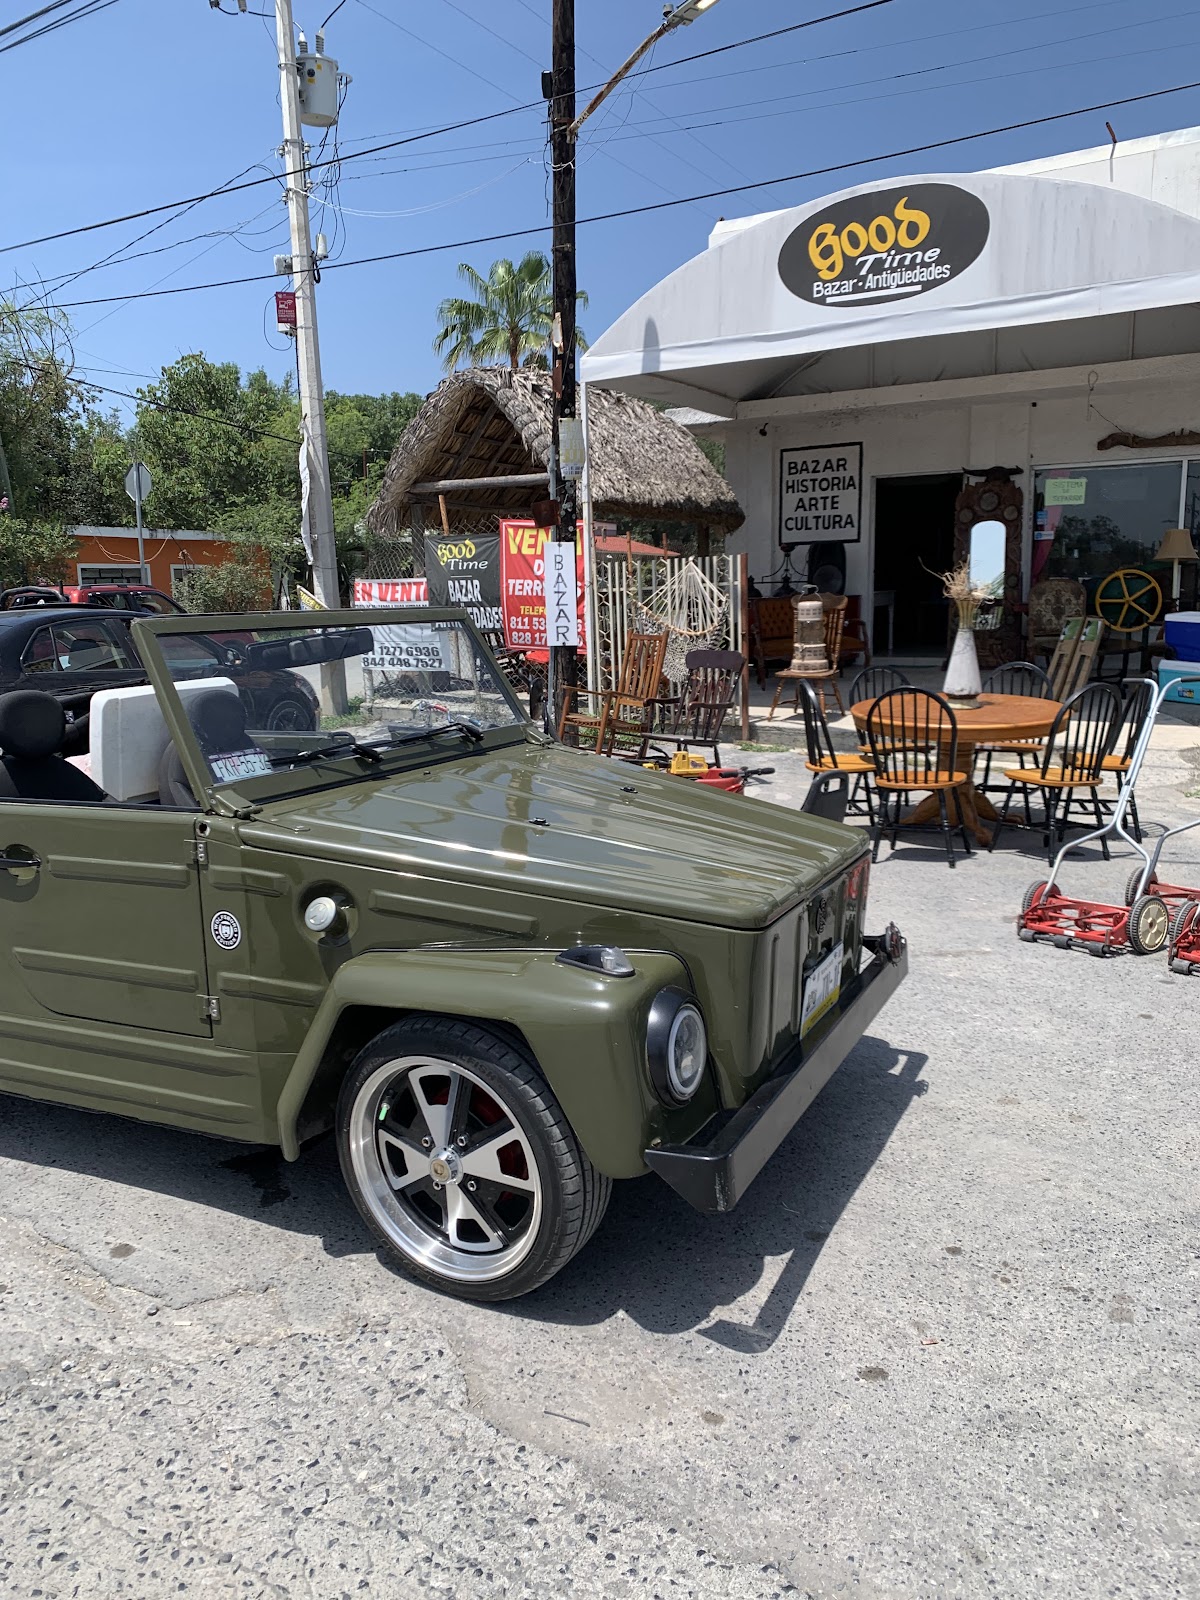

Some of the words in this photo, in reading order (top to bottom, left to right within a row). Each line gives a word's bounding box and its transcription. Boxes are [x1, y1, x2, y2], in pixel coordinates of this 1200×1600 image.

[855, 247, 941, 276] Time
[813, 278, 857, 298] Bazar
[865, 263, 951, 289] Antigüedades
[788, 458, 847, 475] BAZAR
[786, 476, 856, 494] HISTORIA
[794, 495, 840, 512] ARTE
[785, 514, 855, 531] CULTURA
[448, 559, 488, 570] Time
[354, 582, 373, 601] EN
[448, 580, 482, 602] BAZAR
[553, 554, 571, 642] BAZAR
[510, 616, 530, 629] 811
[511, 631, 531, 644] 828
[405, 646, 440, 657] 6936
[362, 657, 385, 667] 844
[388, 658, 411, 668] 448
[413, 658, 443, 668] 7527
